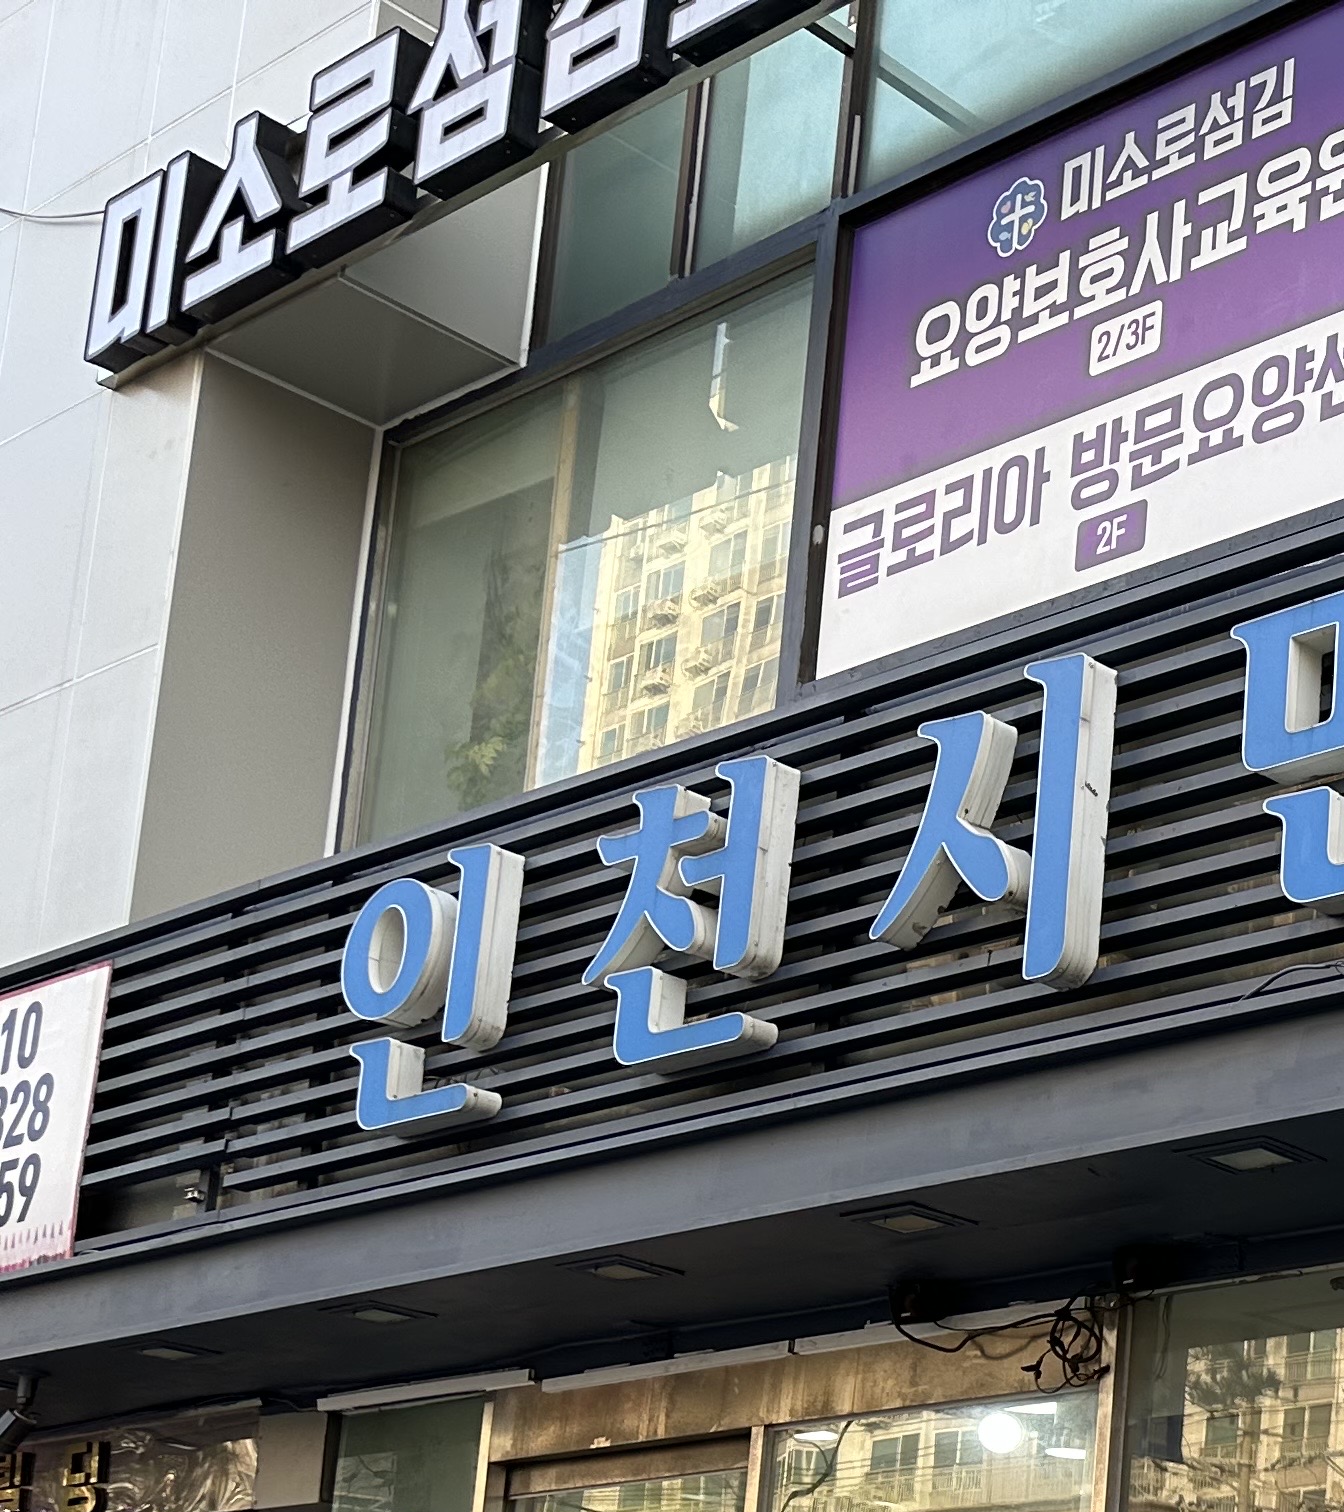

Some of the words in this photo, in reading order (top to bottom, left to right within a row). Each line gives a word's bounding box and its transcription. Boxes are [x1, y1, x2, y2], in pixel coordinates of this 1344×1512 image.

[1060, 58, 1296, 220] 미소로섬김
[1097, 309, 1156, 366] 2/3F
[837, 445, 1053, 600] 글로리아
[1094, 514, 1127, 556] 2F
